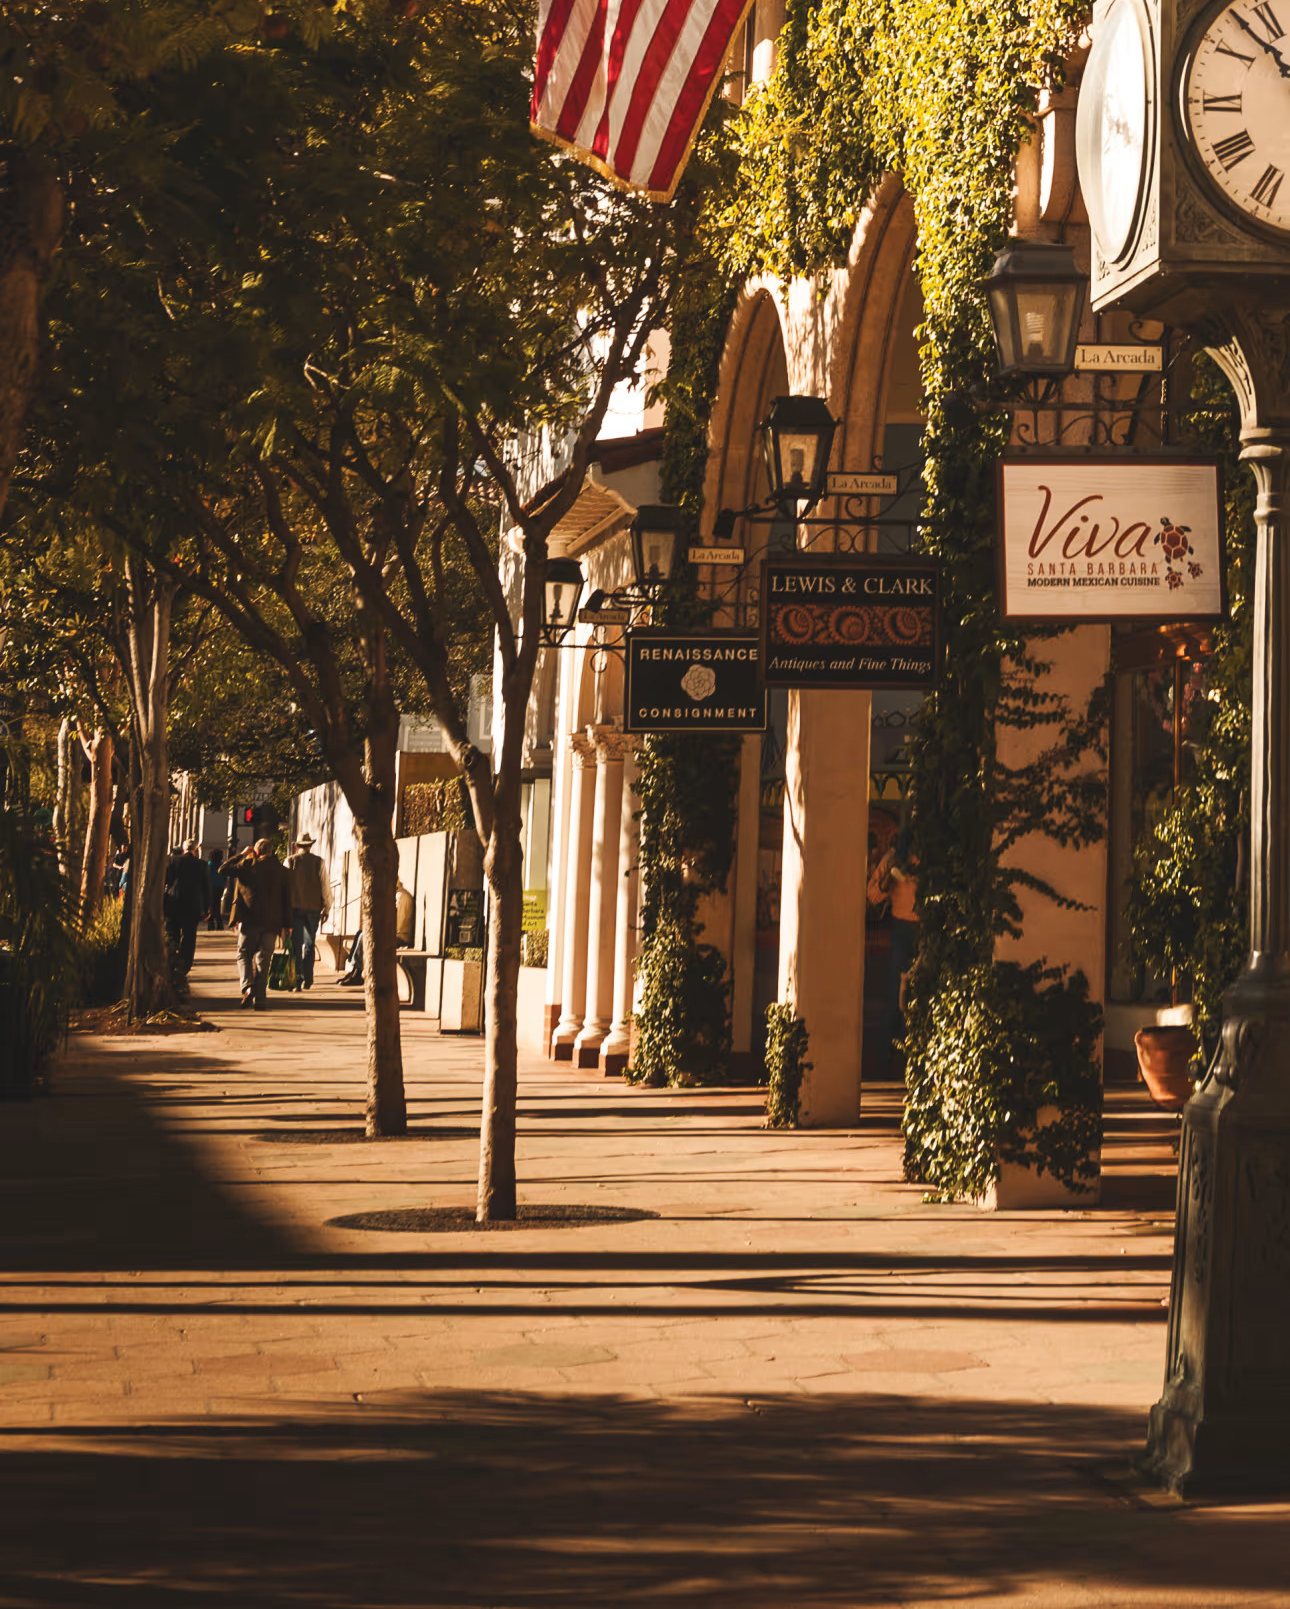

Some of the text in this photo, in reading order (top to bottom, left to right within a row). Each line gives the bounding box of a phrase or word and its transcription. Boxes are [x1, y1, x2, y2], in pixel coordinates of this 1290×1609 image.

[1249, 0, 1288, 44] XI
[1214, 38, 1256, 71] X
[1202, 90, 1242, 114] IX
[1081, 349, 1155, 364] La Arcada
[832, 477, 892, 491] La Arcada
[1028, 485, 1152, 559] Viva
[692, 551, 741, 562] La Arcada
[1027, 562, 1158, 576] SANTA BARBARA
[771, 575, 933, 596] LEWIS & CLARK
[1027, 576, 1160, 587] MODERN MEXICAN CUISINE
[640, 648, 759, 661] RENAISSANCE
[768, 656, 932, 675] Antiques and Fine Things
[639, 707, 757, 719] CONSIGNMENT
